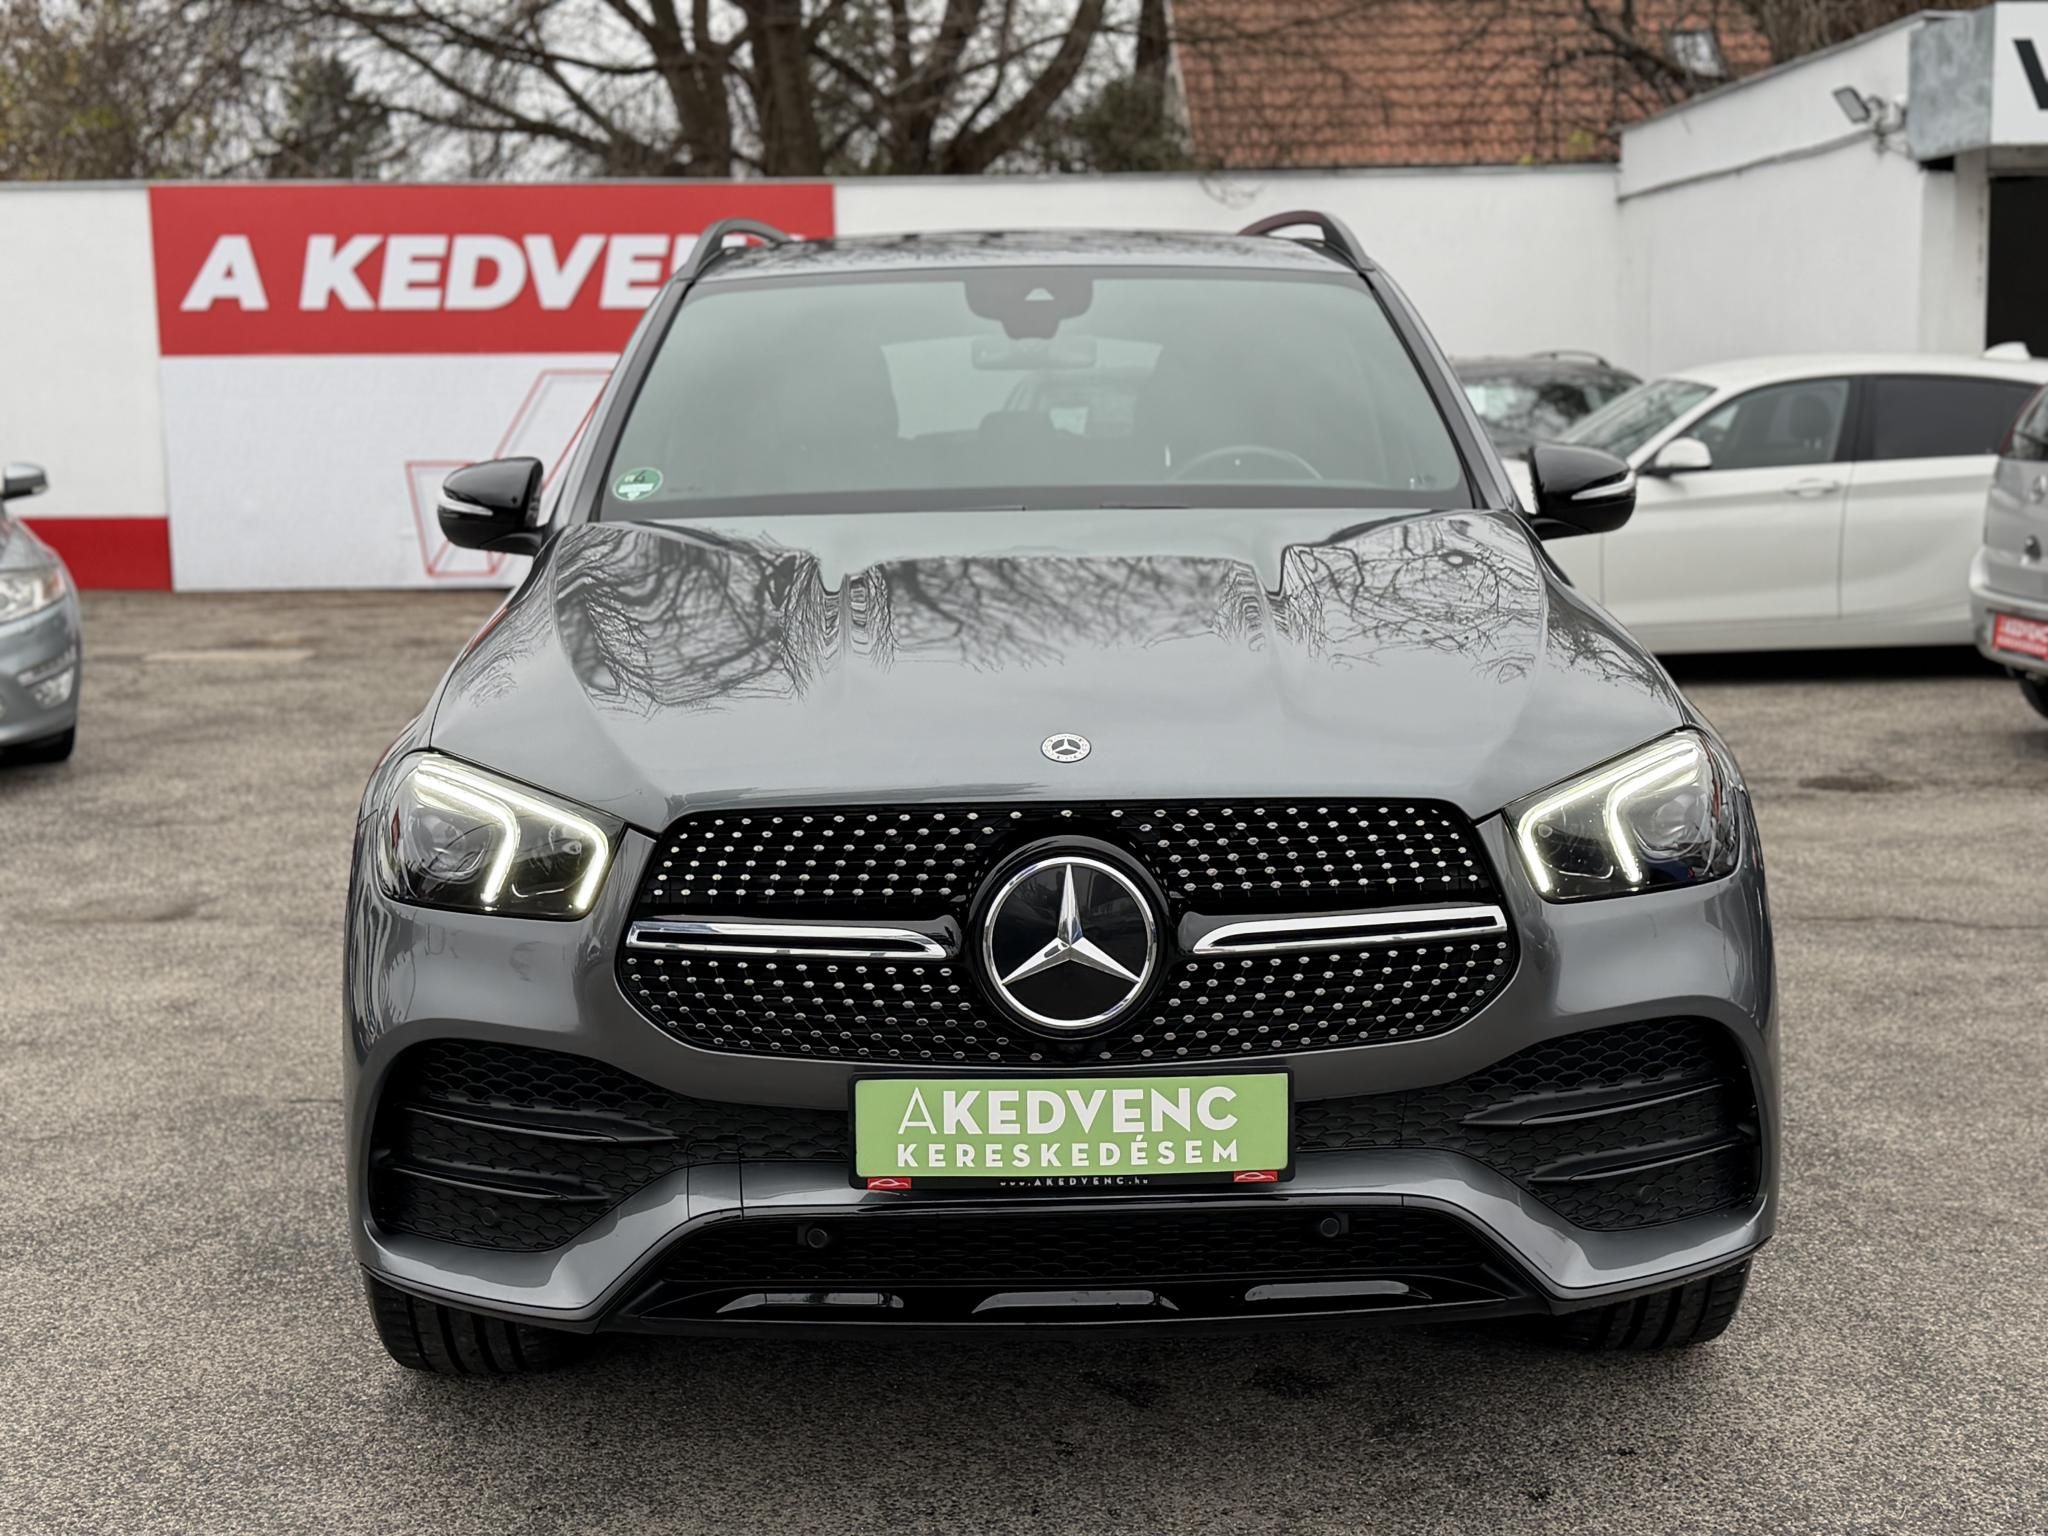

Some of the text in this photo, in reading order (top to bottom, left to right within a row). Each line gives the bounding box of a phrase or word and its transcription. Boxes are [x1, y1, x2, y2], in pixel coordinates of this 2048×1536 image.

[180, 235, 804, 311] A KEDVE
[897, 1135, 1238, 1168] KERESKEDÉSEM
